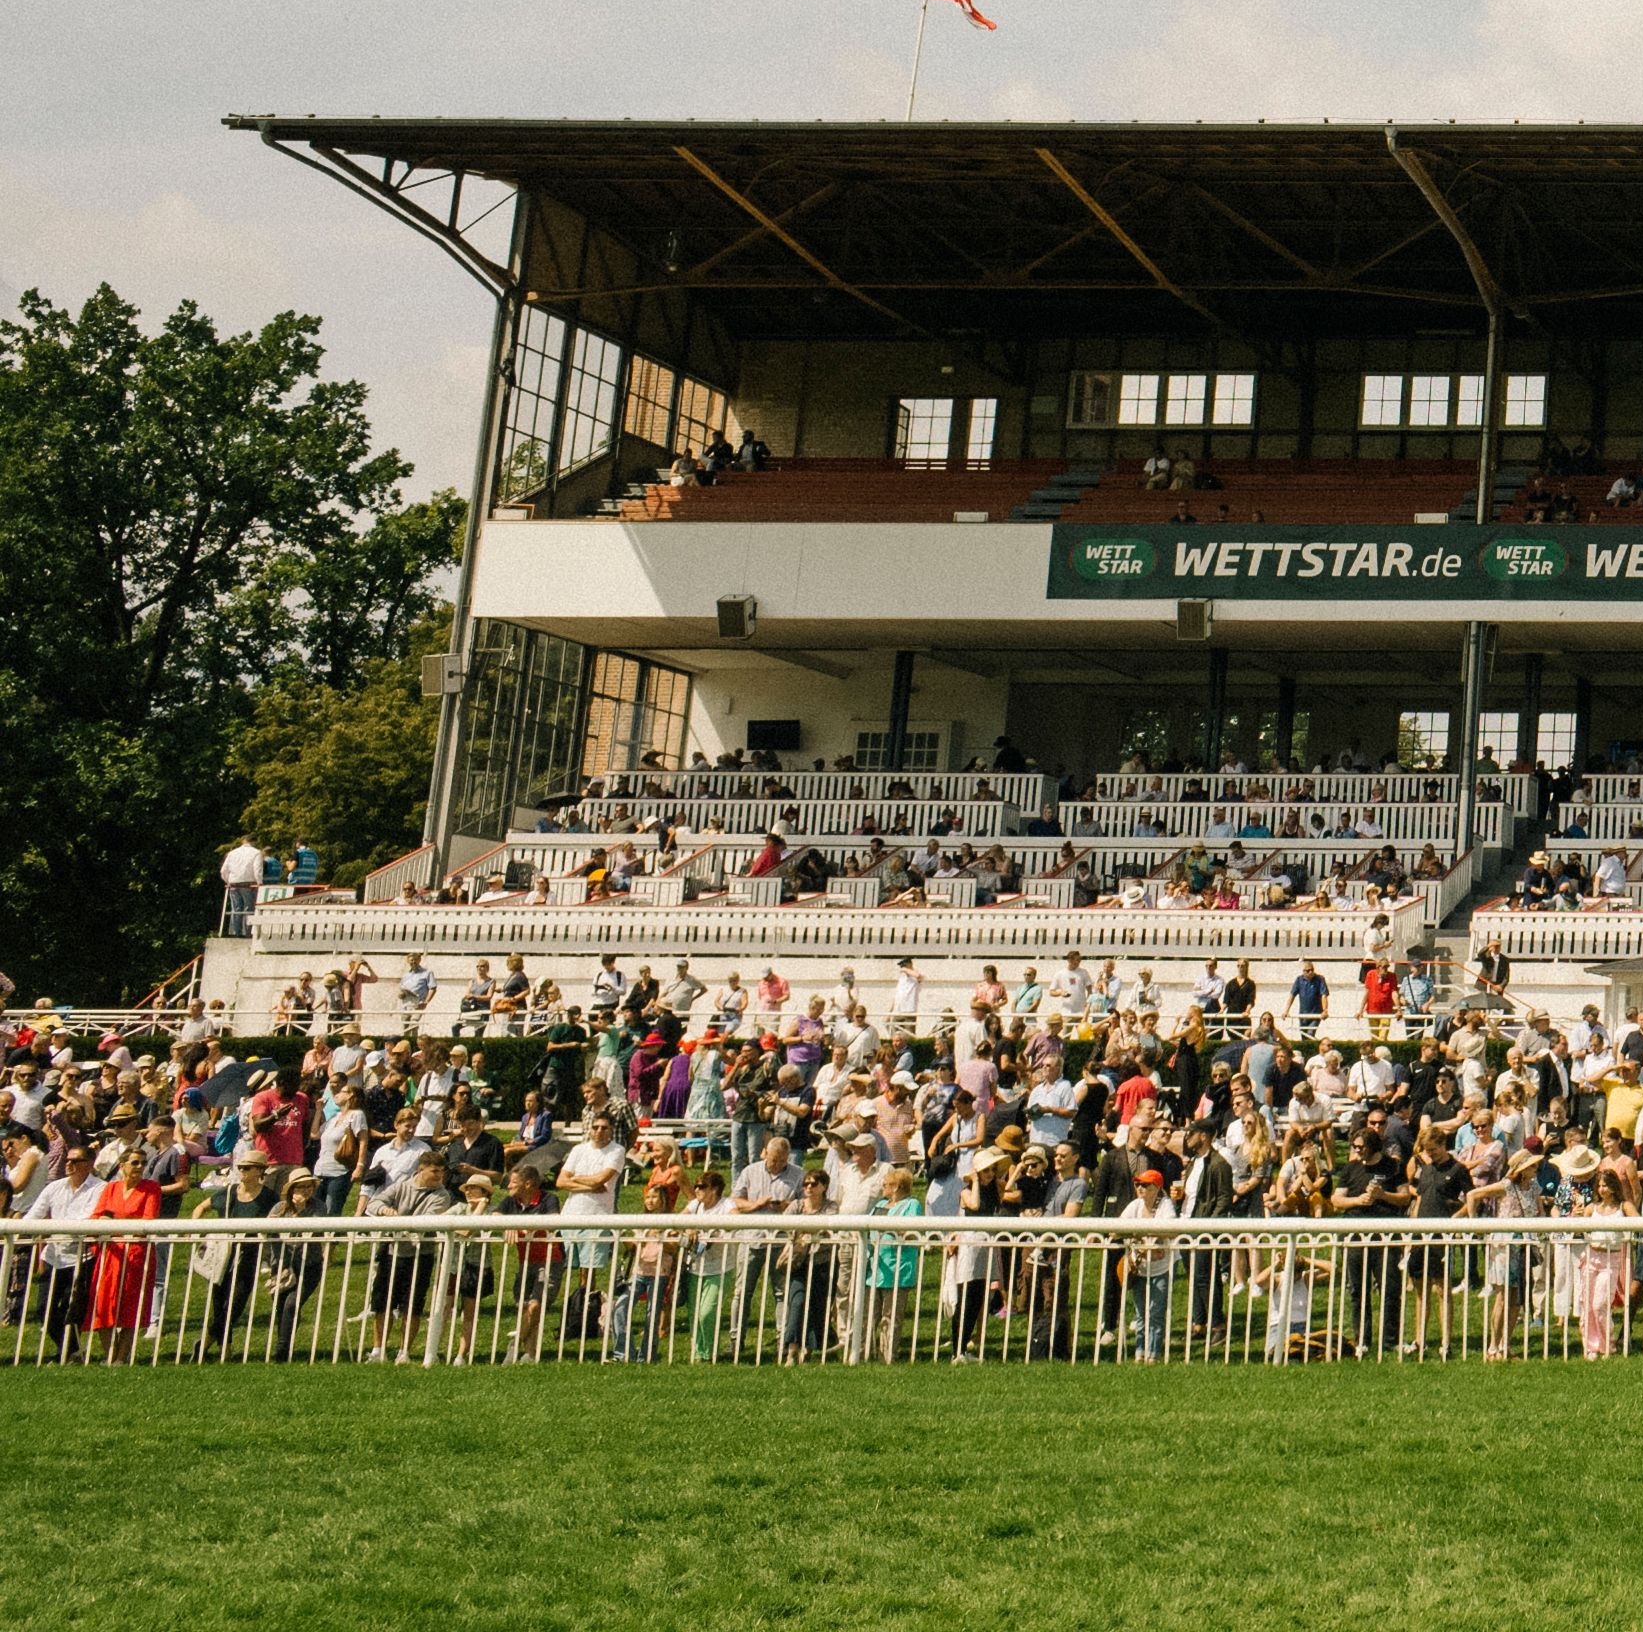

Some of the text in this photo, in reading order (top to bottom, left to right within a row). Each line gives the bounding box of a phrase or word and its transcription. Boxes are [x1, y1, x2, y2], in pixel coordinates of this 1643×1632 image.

[1085, 544, 1136, 559] WETT
[1496, 545, 1546, 560] WETT
[1097, 559, 1143, 575] STAR
[1173, 542, 1462, 578] WETTSTAR.de
[1507, 560, 1554, 575] STAR
